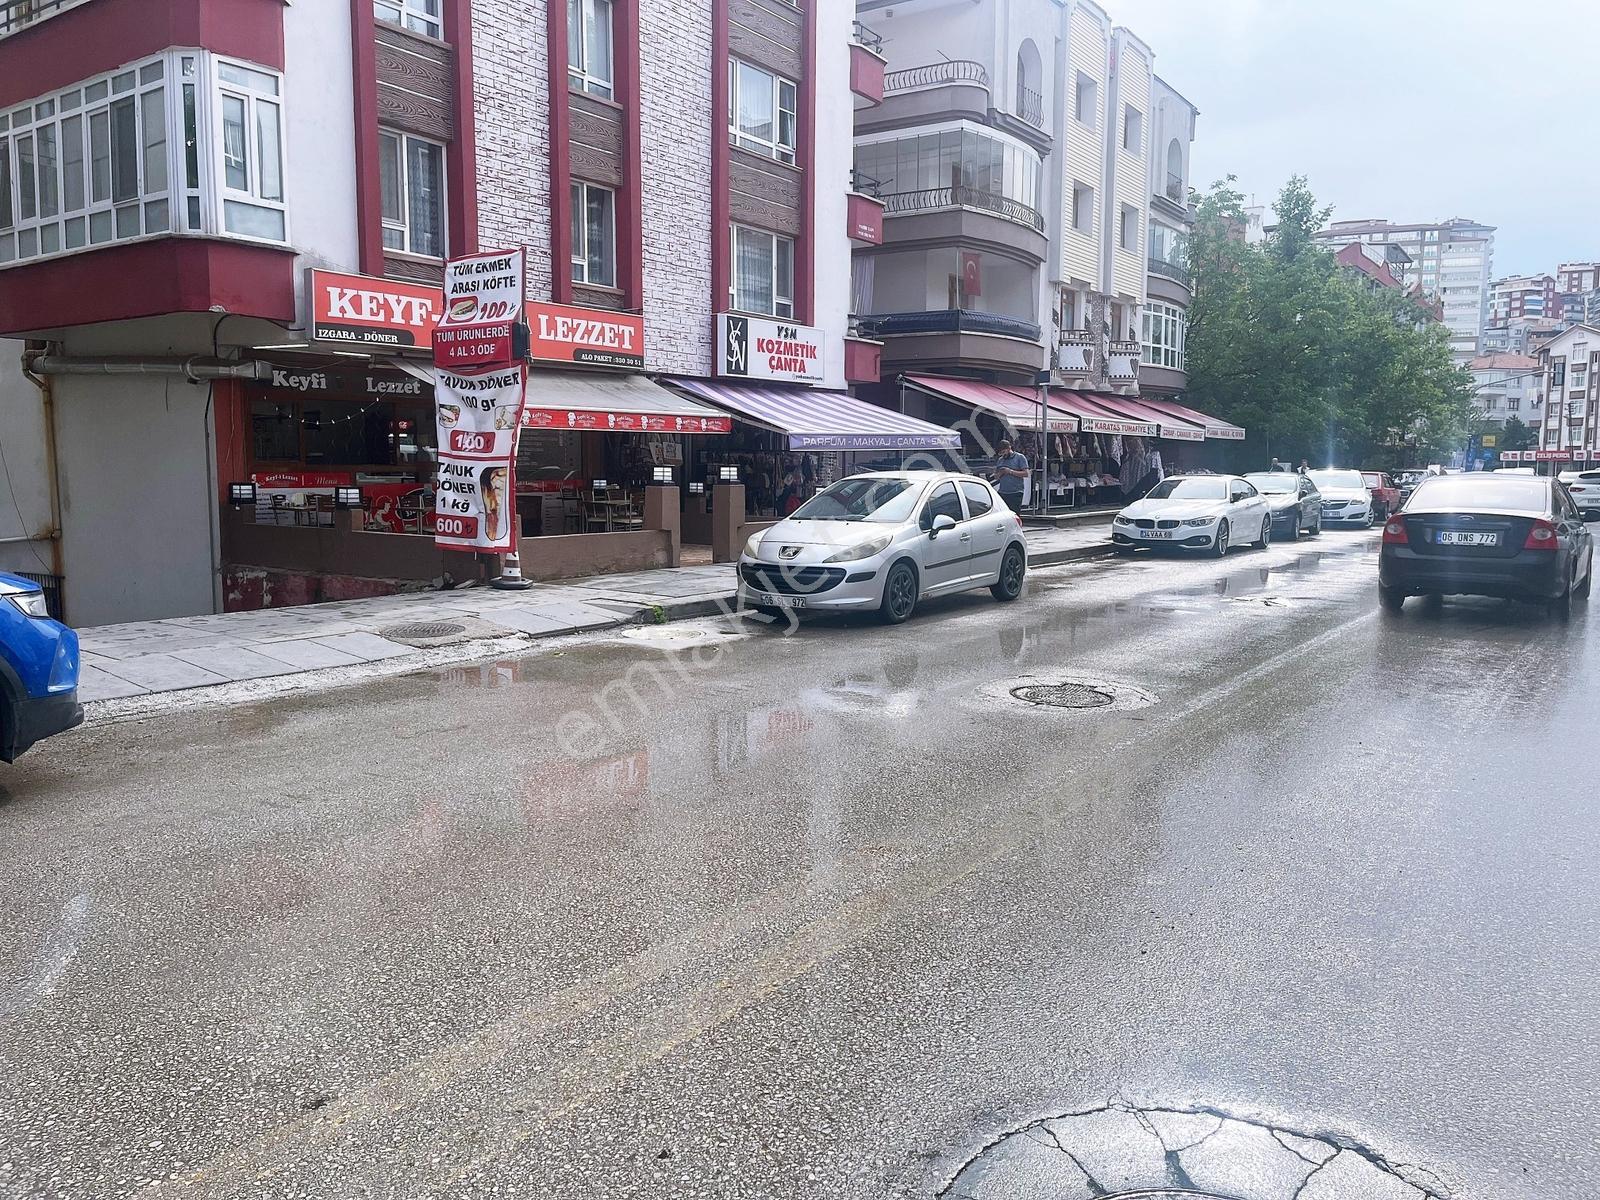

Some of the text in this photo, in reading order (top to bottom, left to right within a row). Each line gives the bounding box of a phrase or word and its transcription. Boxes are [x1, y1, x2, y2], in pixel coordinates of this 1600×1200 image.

[453, 257, 512, 277] TÜM EKMEK
[451, 275, 516, 295] ARASI KÖFTE
[479, 300, 508, 321] 100
[318, 329, 399, 344] IZGARA DÖNER
[537, 314, 635, 350] LEZZET
[777, 325, 798, 340] YSN
[449, 342, 496, 358] 4 AL 3 ÖDE
[756, 337, 817, 360] KOZMETİK
[581, 353, 593, 361] ALO
[593, 354, 613, 363] PAKET
[768, 355, 807, 374] ÇANTA
[272, 370, 421, 394] Keyfi Lezzet
[477, 372, 520, 391] DÖNER
[481, 398, 497, 412] gr
[802, 436, 846, 446] PARFÜM
[853, 437, 891, 446] MAKYAJ
[437, 461, 475, 478] TAVUK
[440, 496, 446, 508] 1
[436, 517, 463, 534] 600
[1442, 532, 1453, 542] 06
[1479, 533, 1496, 543] 772
[791, 597, 805, 607] 972
